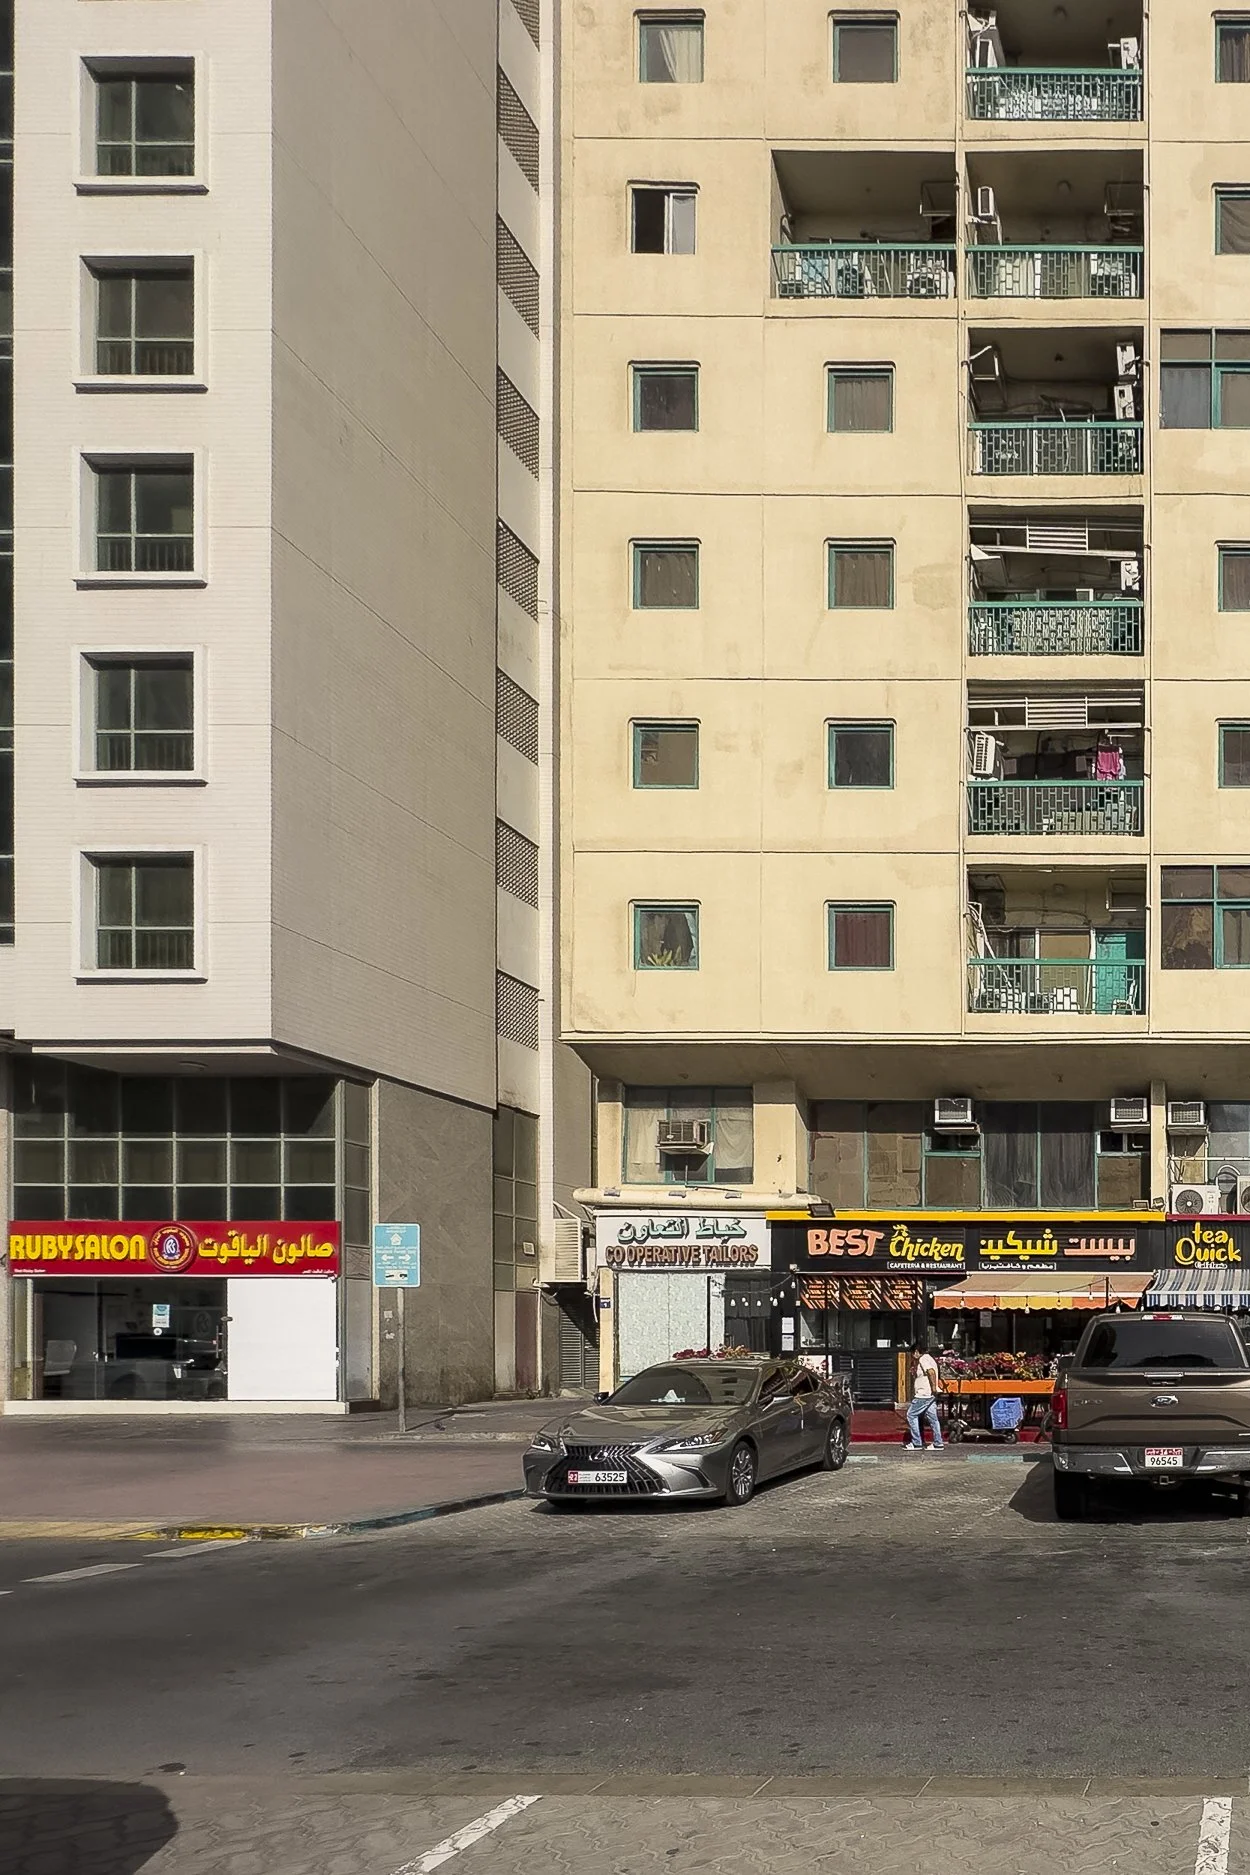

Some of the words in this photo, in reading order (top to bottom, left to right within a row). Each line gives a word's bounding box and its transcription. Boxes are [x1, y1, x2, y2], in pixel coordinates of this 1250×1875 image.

[617, 1217, 689, 1244] التعاون
[695, 1217, 747, 1244] خياط
[1192, 1221, 1229, 1244] tea
[198, 1229, 269, 1266] الياقوت
[272, 1233, 335, 1265] صالون
[605, 1245, 625, 1265] CO
[626, 1245, 701, 1265] OPERATIVE
[702, 1245, 760, 1265] TAILORS
[807, 1228, 885, 1256] BEST
[889, 1229, 965, 1262] Chicken
[1063, 1238, 1136, 1261] بيست
[1175, 1238, 1242, 1265] Quick
[1150, 1457, 1178, 1466] 96545
[595, 1472, 625, 1482] 63525
